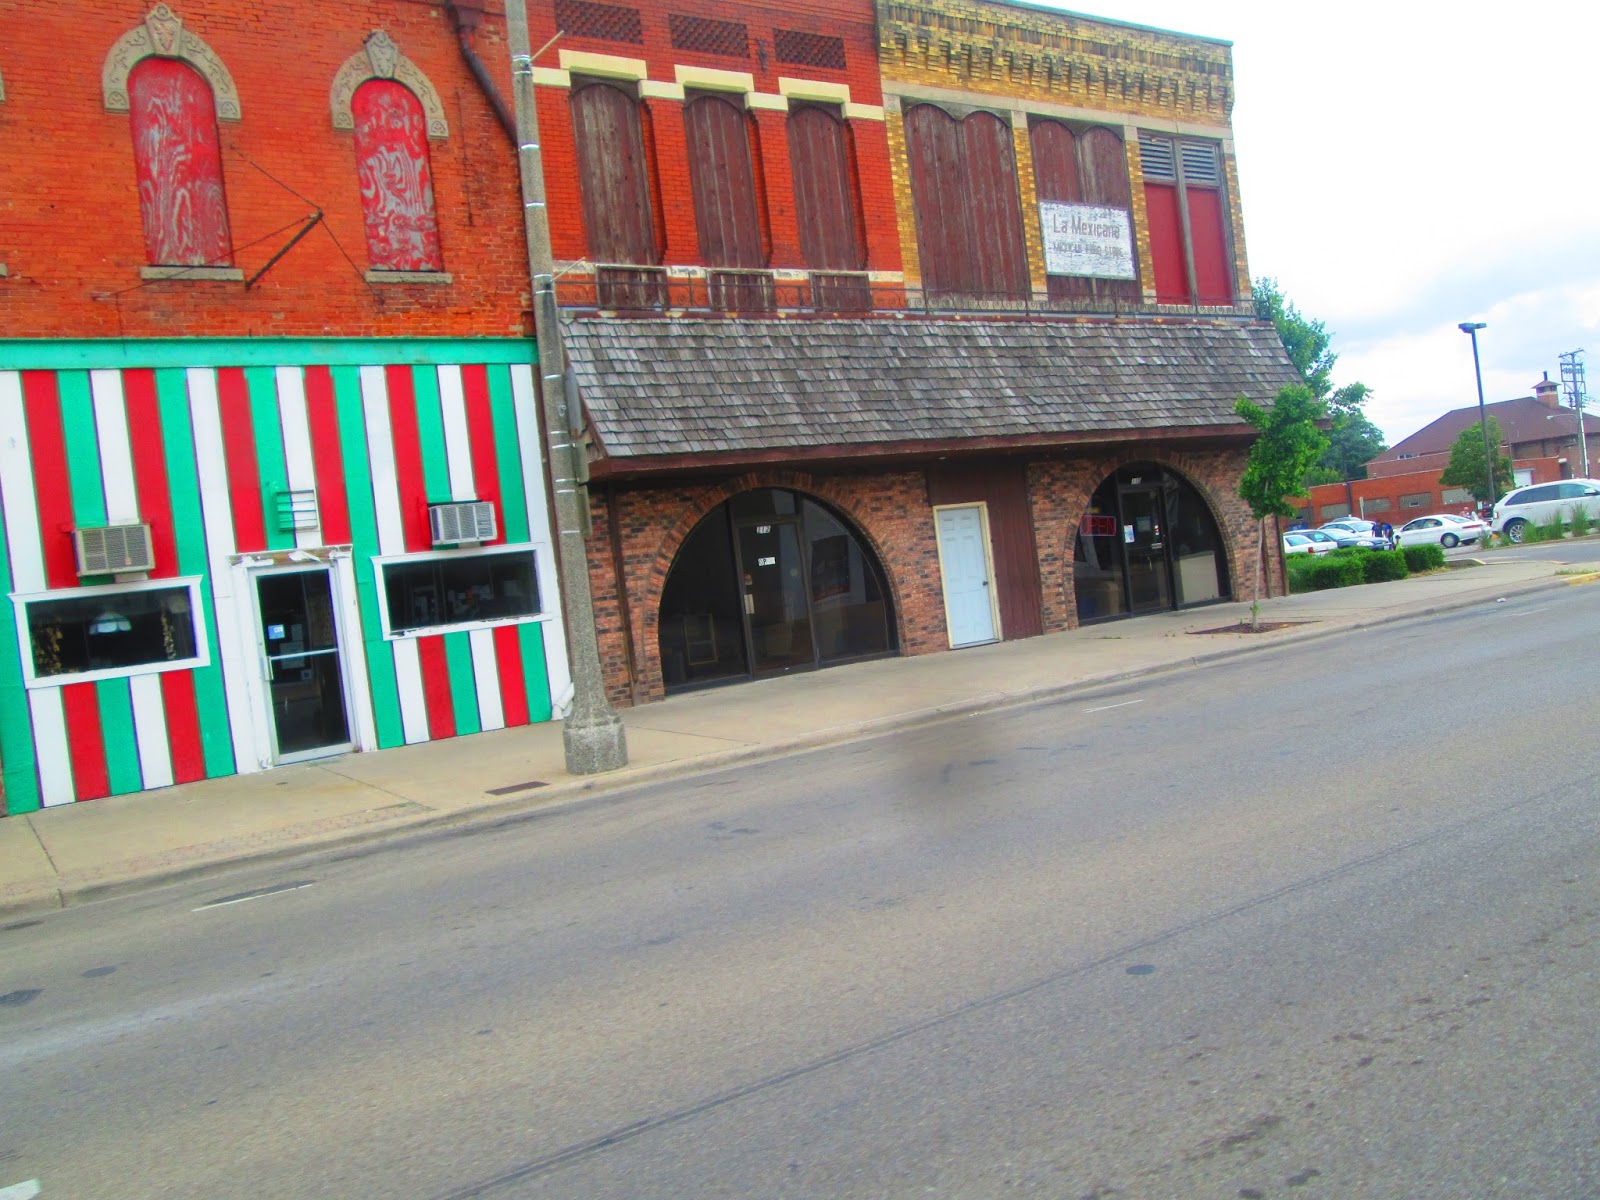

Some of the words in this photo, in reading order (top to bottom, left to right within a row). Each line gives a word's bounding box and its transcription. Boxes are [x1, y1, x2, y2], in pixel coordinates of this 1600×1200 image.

[1053, 213, 1068, 234] La
[1071, 215, 1120, 239] Mexicana
[1081, 515, 1116, 535] OPEN
